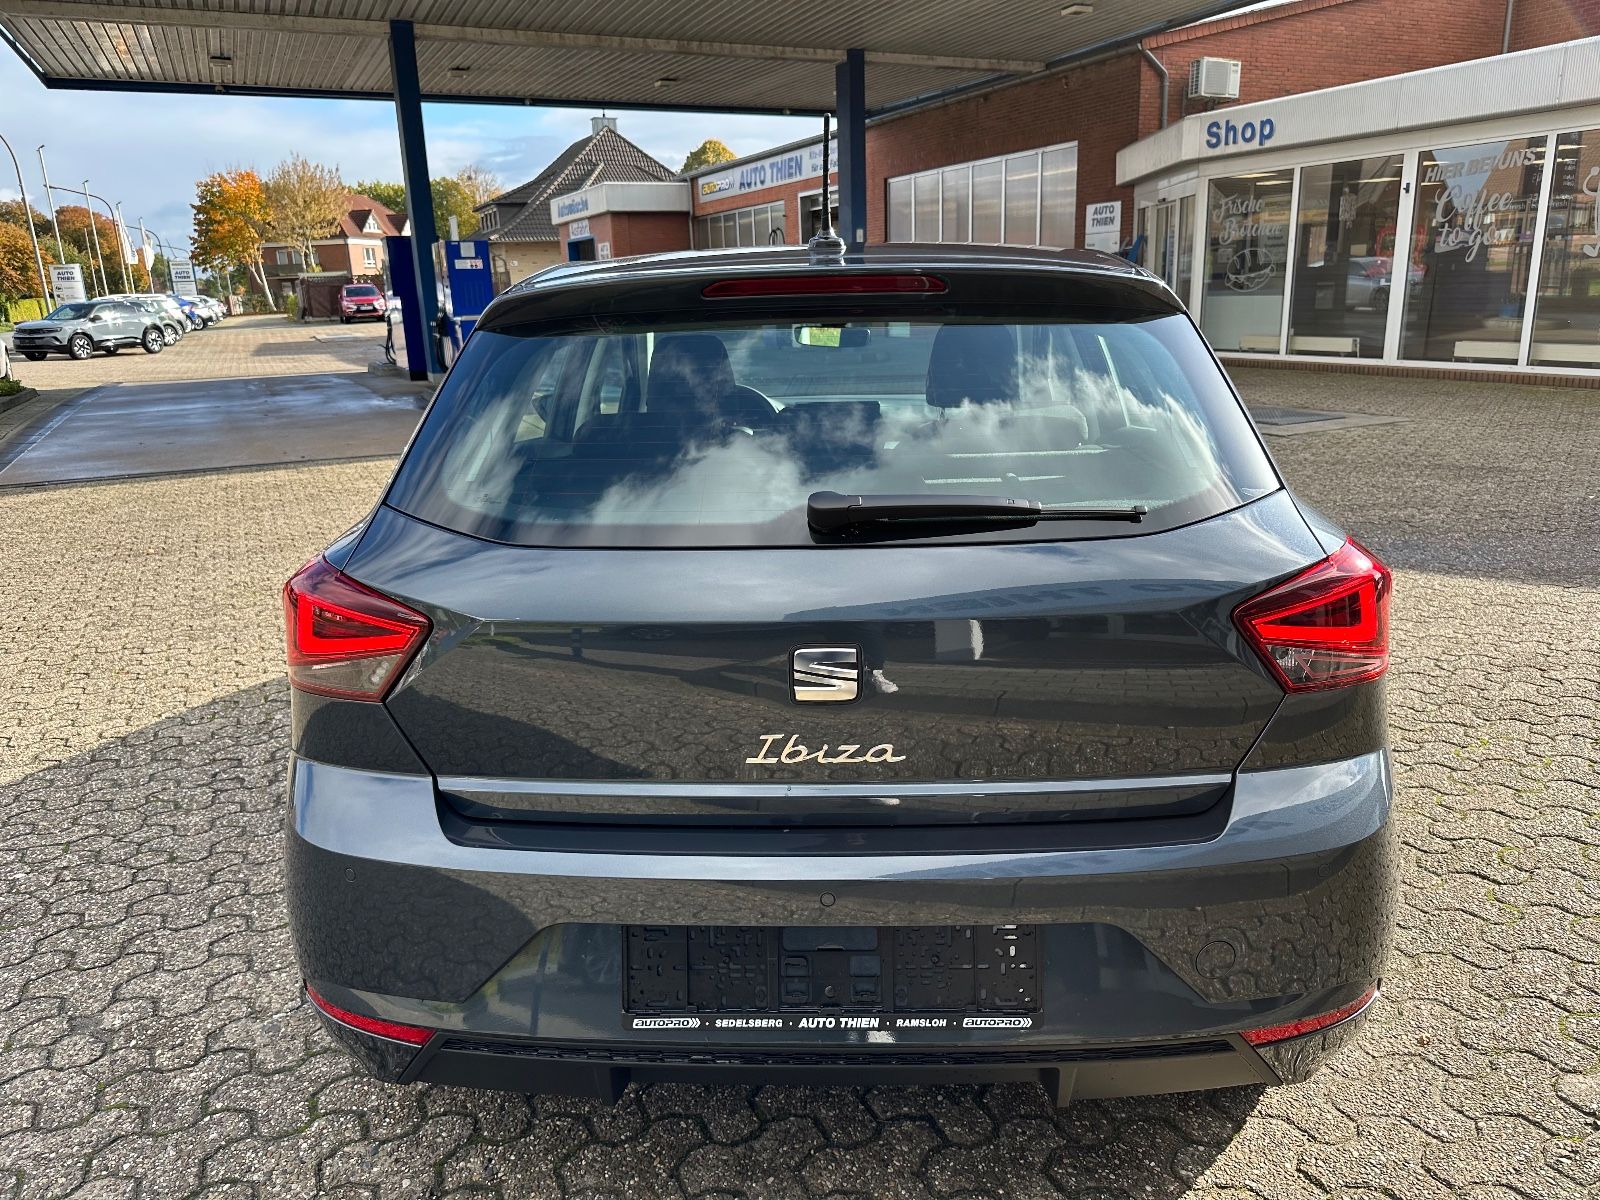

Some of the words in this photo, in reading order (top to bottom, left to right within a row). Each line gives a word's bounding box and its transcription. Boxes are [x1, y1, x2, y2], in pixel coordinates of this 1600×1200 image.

[1205, 118, 1276, 149] Shop
[739, 164, 767, 191] AUTO
[769, 154, 803, 183] THIEN
[1425, 162, 1464, 183] HIER
[1466, 155, 1499, 176] BEI
[1498, 147, 1536, 170] UNS
[1091, 215, 1115, 228] THIEN
[1093, 205, 1115, 216] AUTO
[1435, 184, 1514, 232] Coffee
[1438, 222, 1463, 247] to
[1468, 225, 1498, 263] go
[745, 733, 907, 764] Ibiza
[715, 1018, 783, 1028] SEDELSBERG
[799, 1017, 836, 1028] AUTO
[839, 1017, 879, 1028] THIEN
[896, 1018, 947, 1027] RAMSLOH
